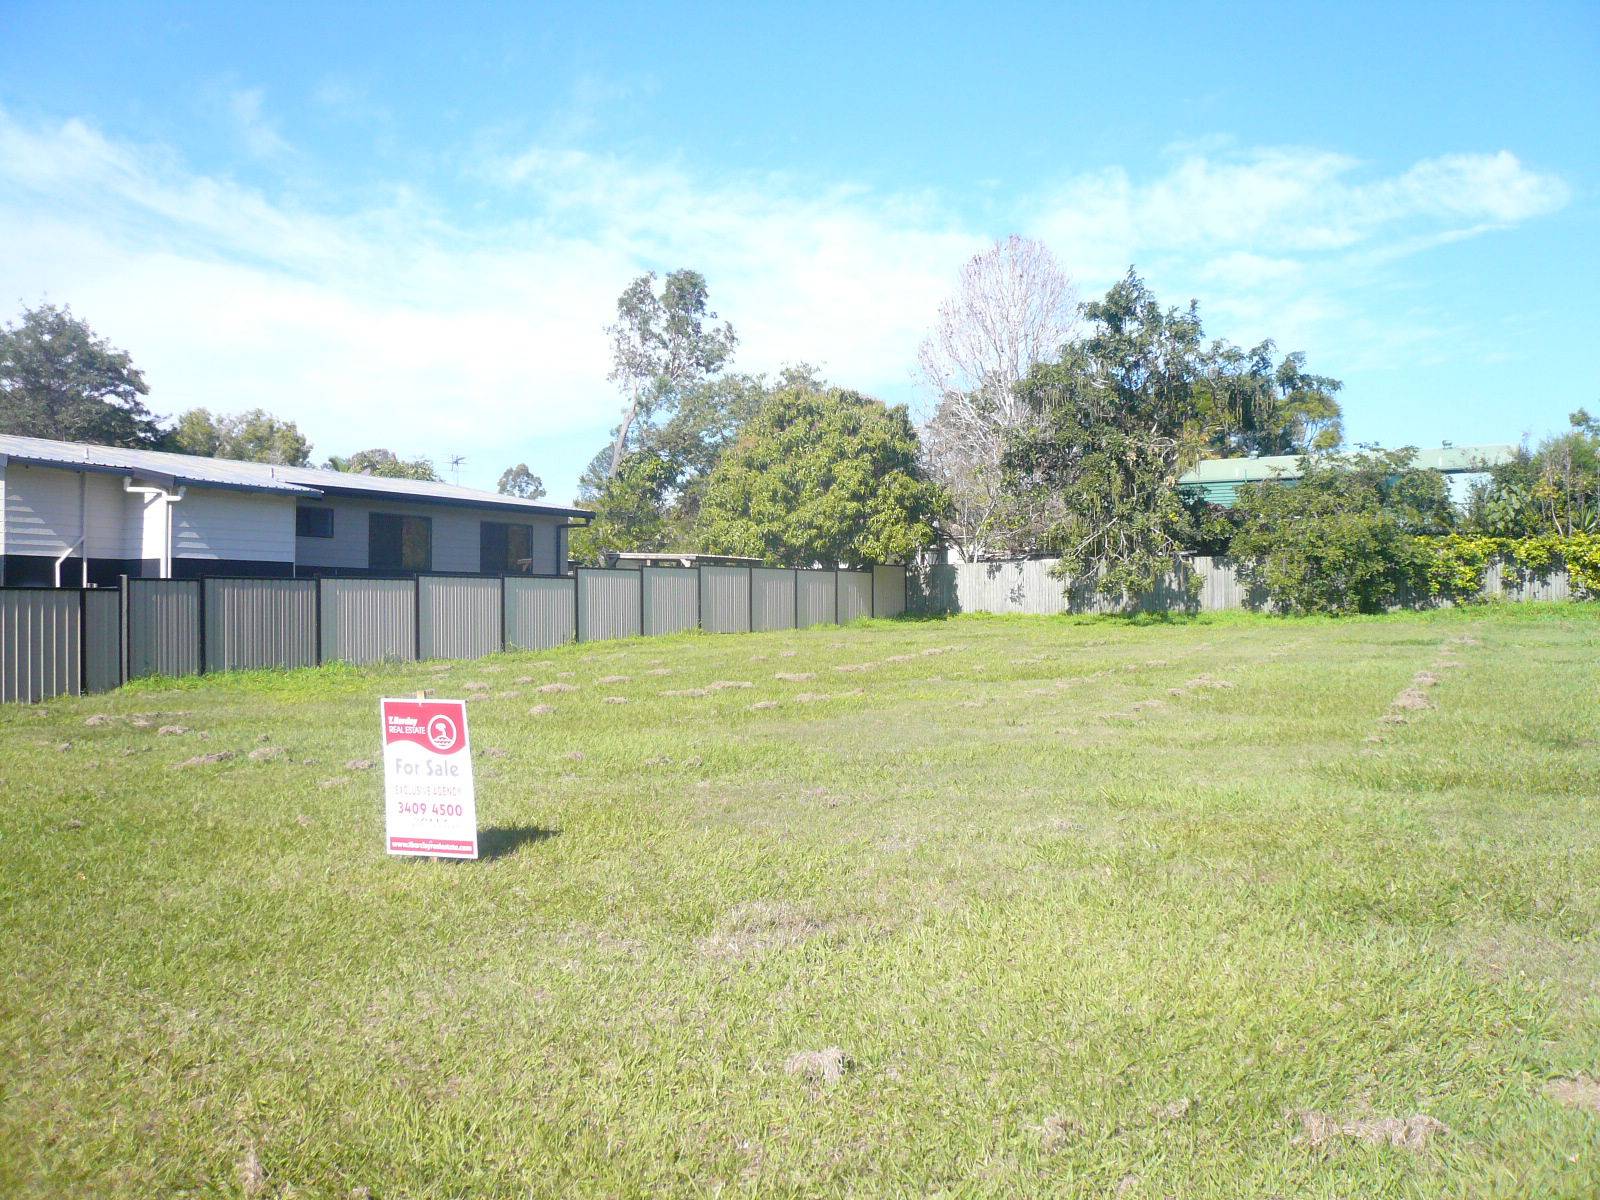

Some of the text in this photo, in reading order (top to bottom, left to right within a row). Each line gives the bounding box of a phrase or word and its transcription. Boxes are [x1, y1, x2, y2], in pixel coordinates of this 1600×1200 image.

[389, 725, 426, 735] REAL ESTATE
[395, 758, 460, 777] For Sale
[398, 801, 463, 817] 3409 4500
